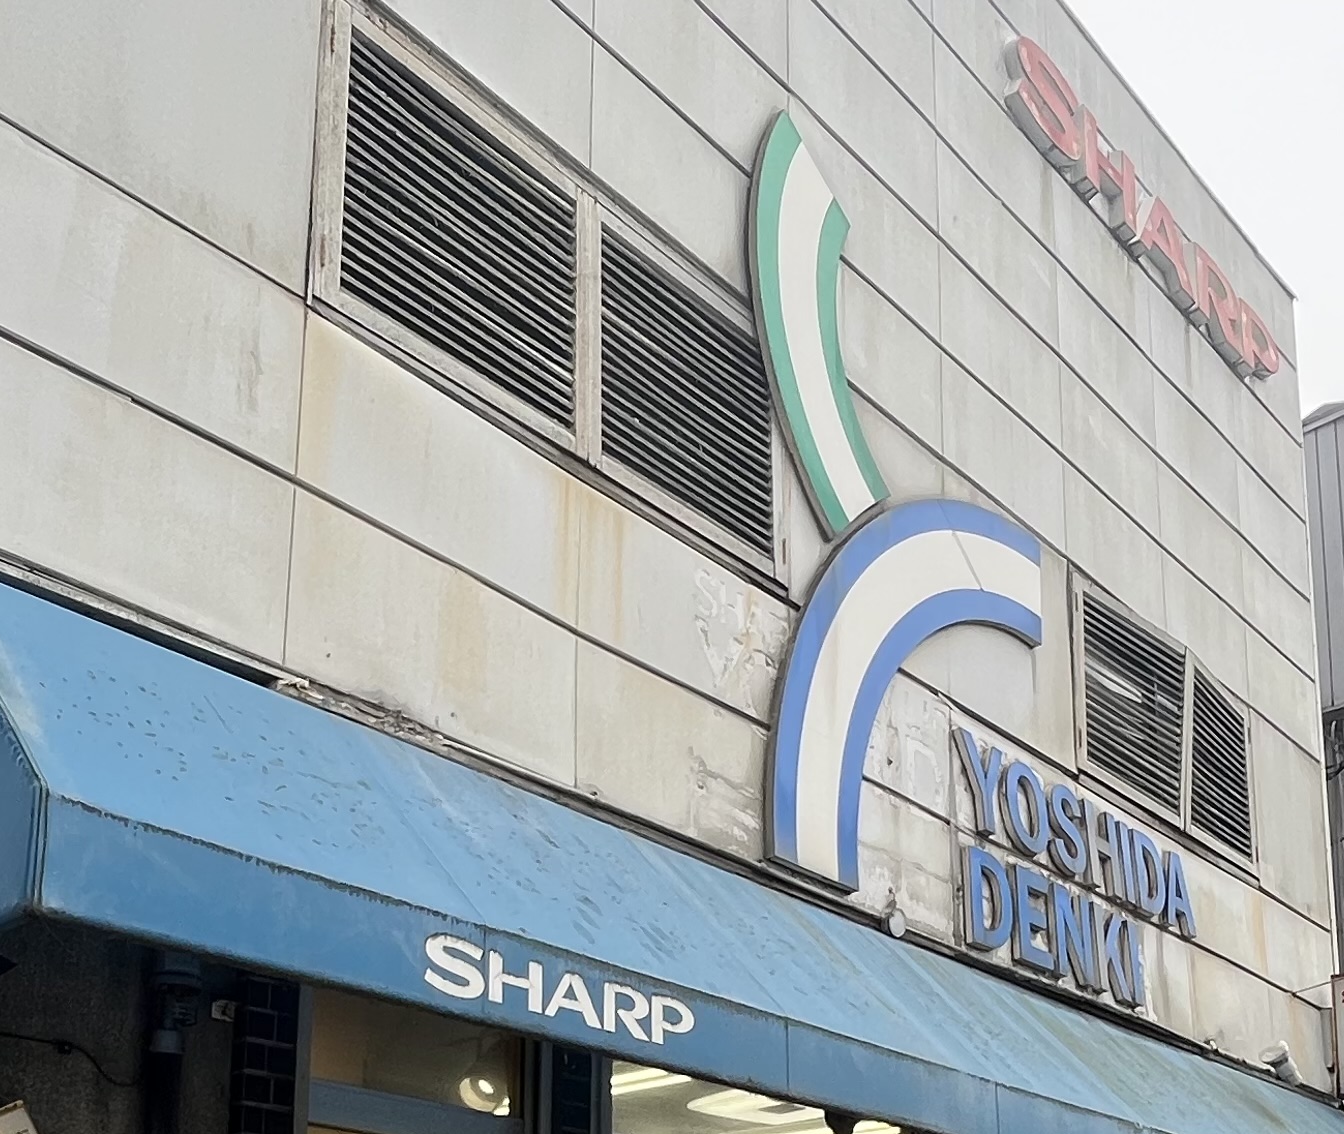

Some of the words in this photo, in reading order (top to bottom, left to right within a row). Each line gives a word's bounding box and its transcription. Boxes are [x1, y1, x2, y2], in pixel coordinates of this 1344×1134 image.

[1008, 36, 1279, 376] SHARP
[954, 727, 1198, 940] YOSHIDA
[964, 846, 1145, 1008] DENKI
[424, 932, 696, 1045] SHARP
